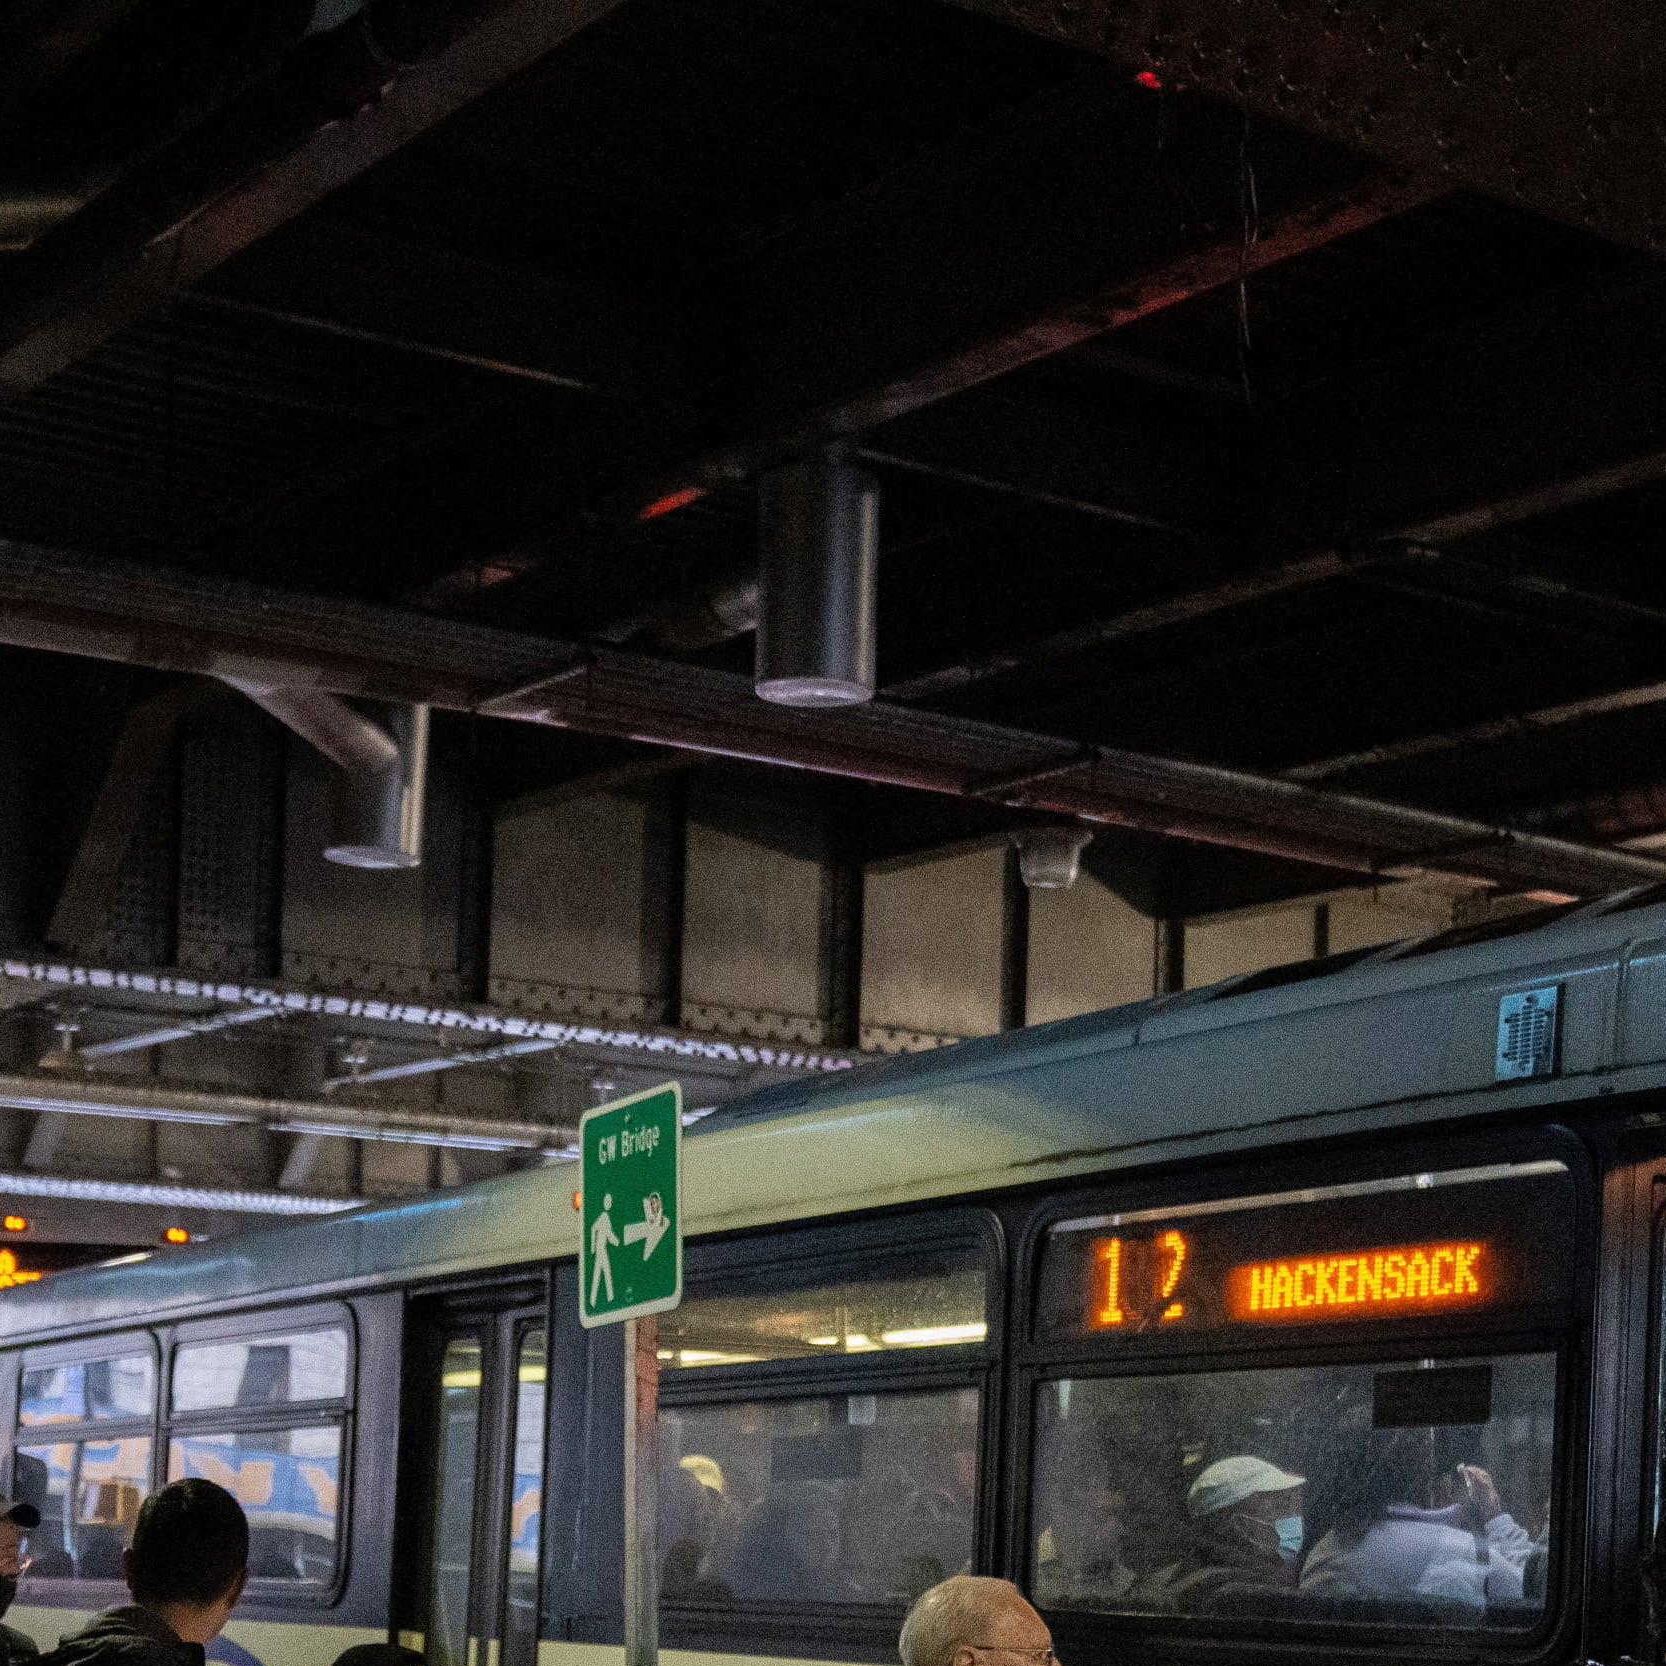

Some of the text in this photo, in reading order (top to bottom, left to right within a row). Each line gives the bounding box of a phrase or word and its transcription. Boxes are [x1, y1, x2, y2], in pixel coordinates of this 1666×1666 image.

[598, 1124, 661, 1166] GW Bridge
[1249, 1246, 1481, 1310] HACKENSACK
